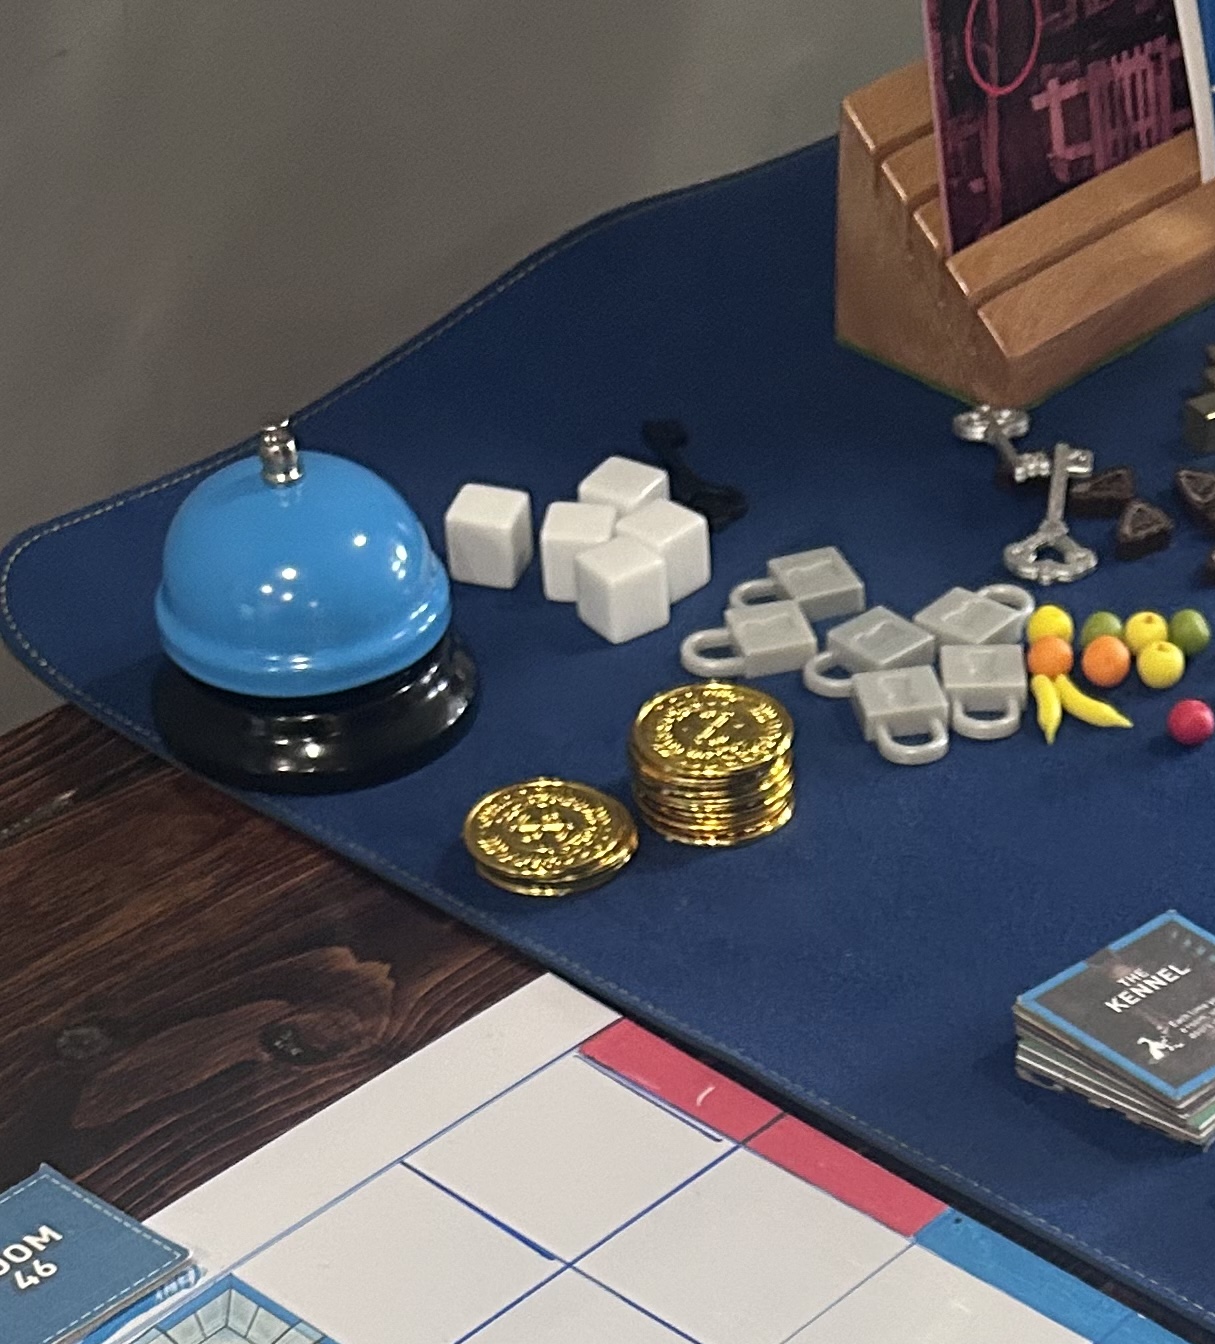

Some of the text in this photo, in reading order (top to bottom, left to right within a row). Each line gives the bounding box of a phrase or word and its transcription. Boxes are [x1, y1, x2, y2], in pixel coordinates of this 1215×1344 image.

[1104, 964, 1192, 1013] KENNEL
[1116, 968, 1150, 987] THE
[14, 1259, 58, 1290] 46
